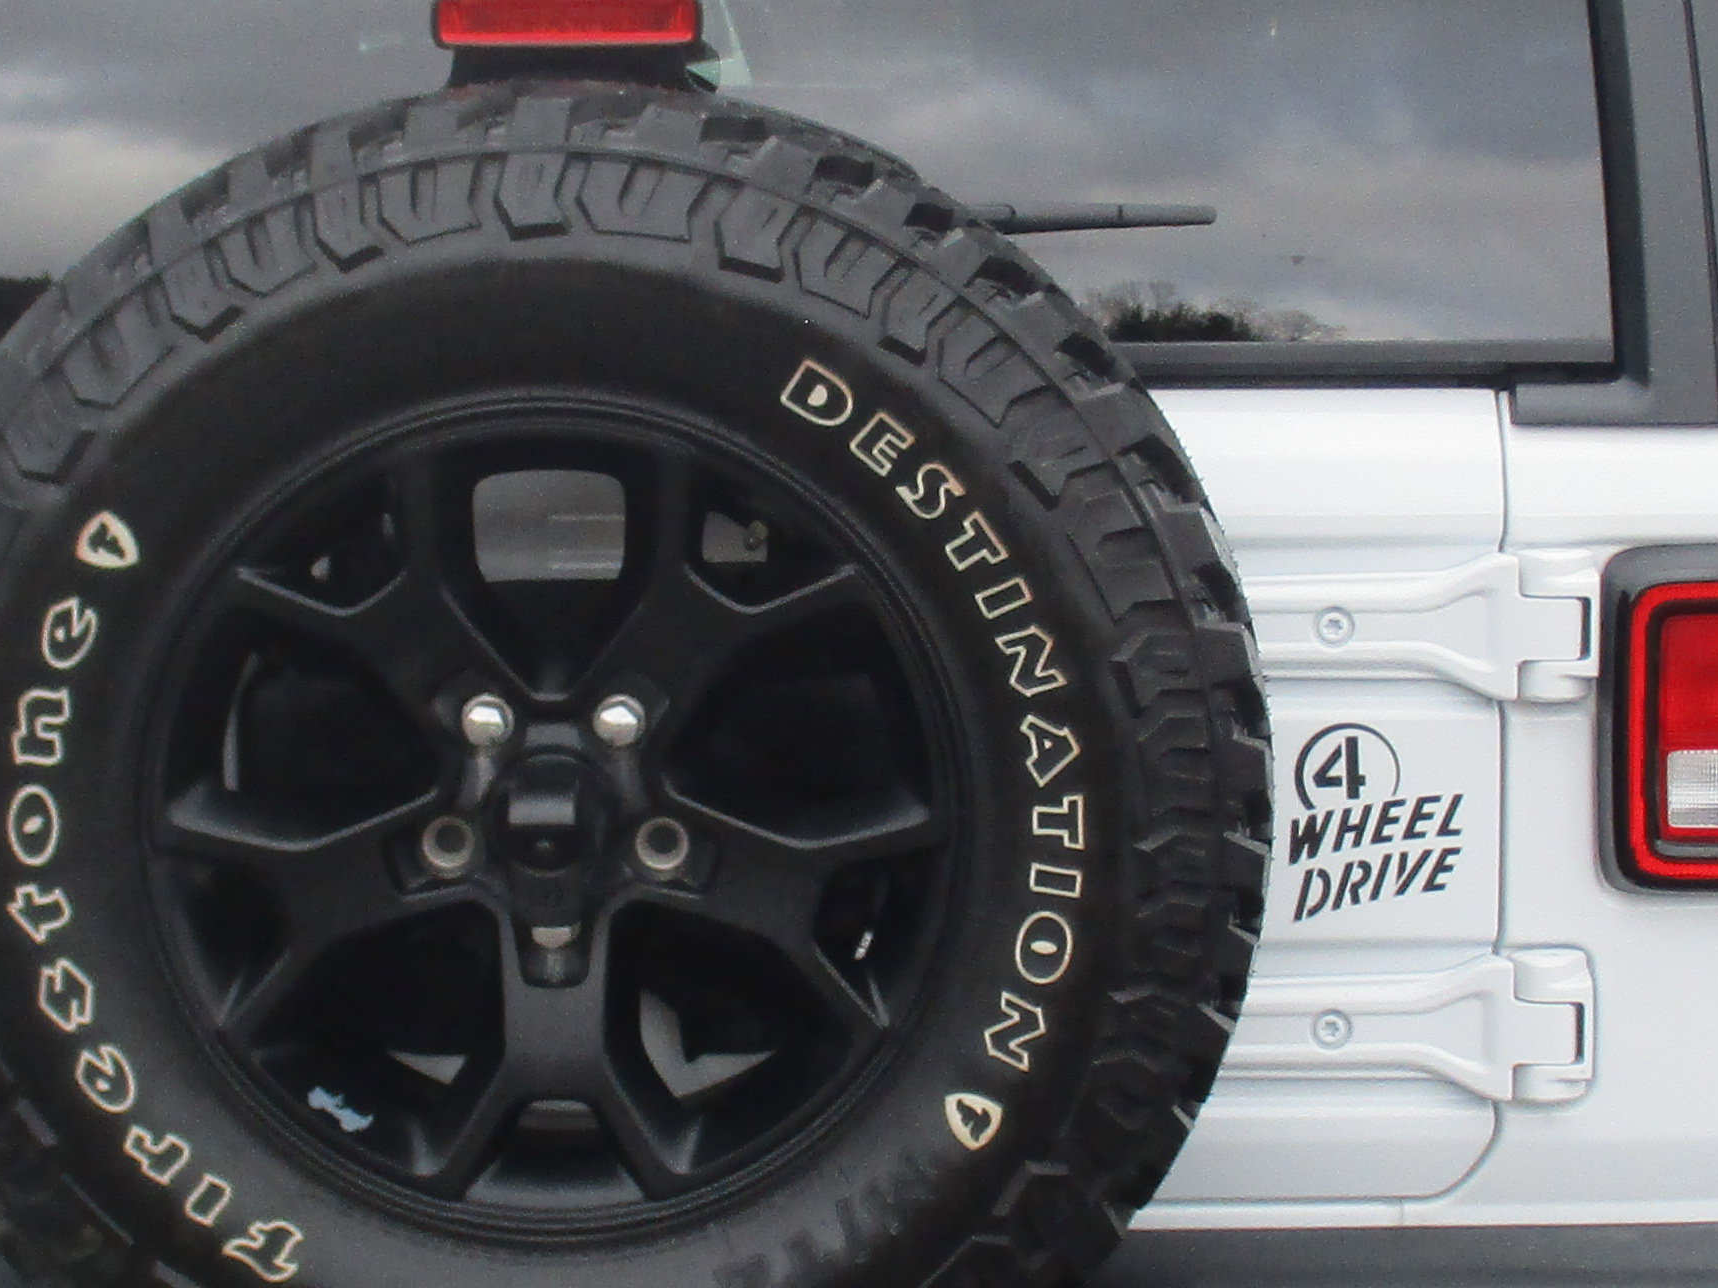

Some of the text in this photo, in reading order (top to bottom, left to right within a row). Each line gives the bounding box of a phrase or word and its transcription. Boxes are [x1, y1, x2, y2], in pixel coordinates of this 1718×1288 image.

[780, 358, 1084, 1072] DESTINATION
[1312, 735, 1367, 800] 4
[1289, 793, 1464, 866] WHEEL
[1292, 846, 1463, 923] DRIVE
[8, 597, 304, 1282] Firestone
